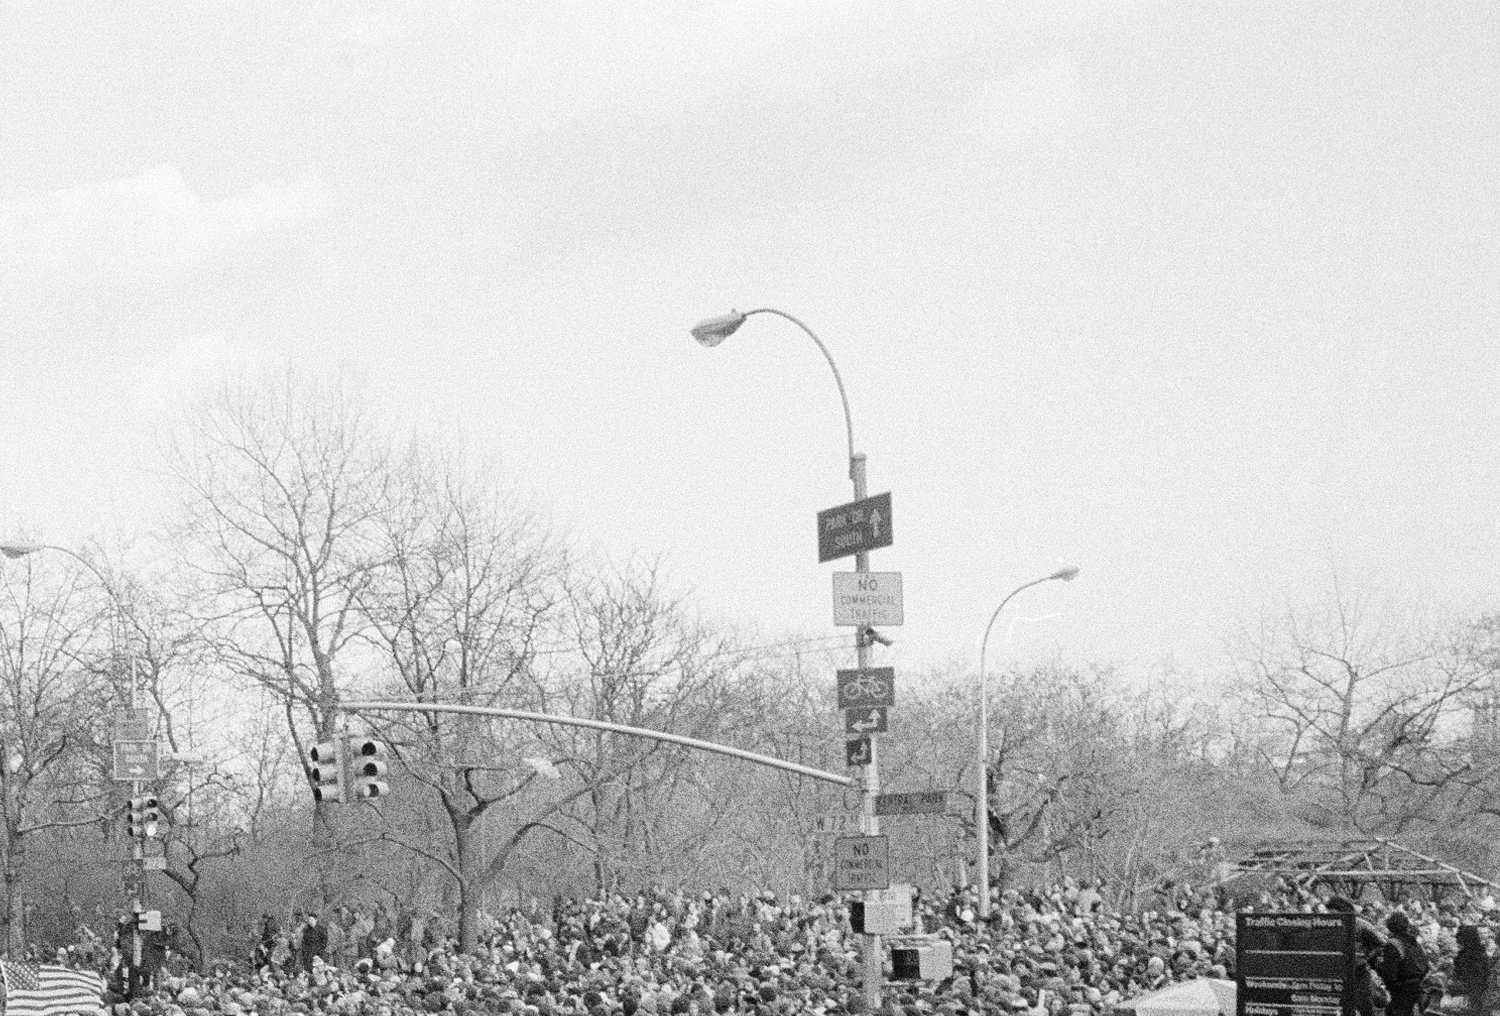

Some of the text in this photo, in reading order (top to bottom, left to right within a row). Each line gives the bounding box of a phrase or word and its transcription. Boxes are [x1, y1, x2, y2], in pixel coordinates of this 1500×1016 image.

[858, 579, 878, 591] NO
[839, 594, 896, 606] COMMERCIAL
[850, 607, 889, 620] TRAFFIC
[831, 815, 847, 831] 72
[853, 843, 870, 855] NO
[840, 858, 884, 870] COMMERCIAL
[1245, 917, 1343, 929] Traffic Closing Hours
